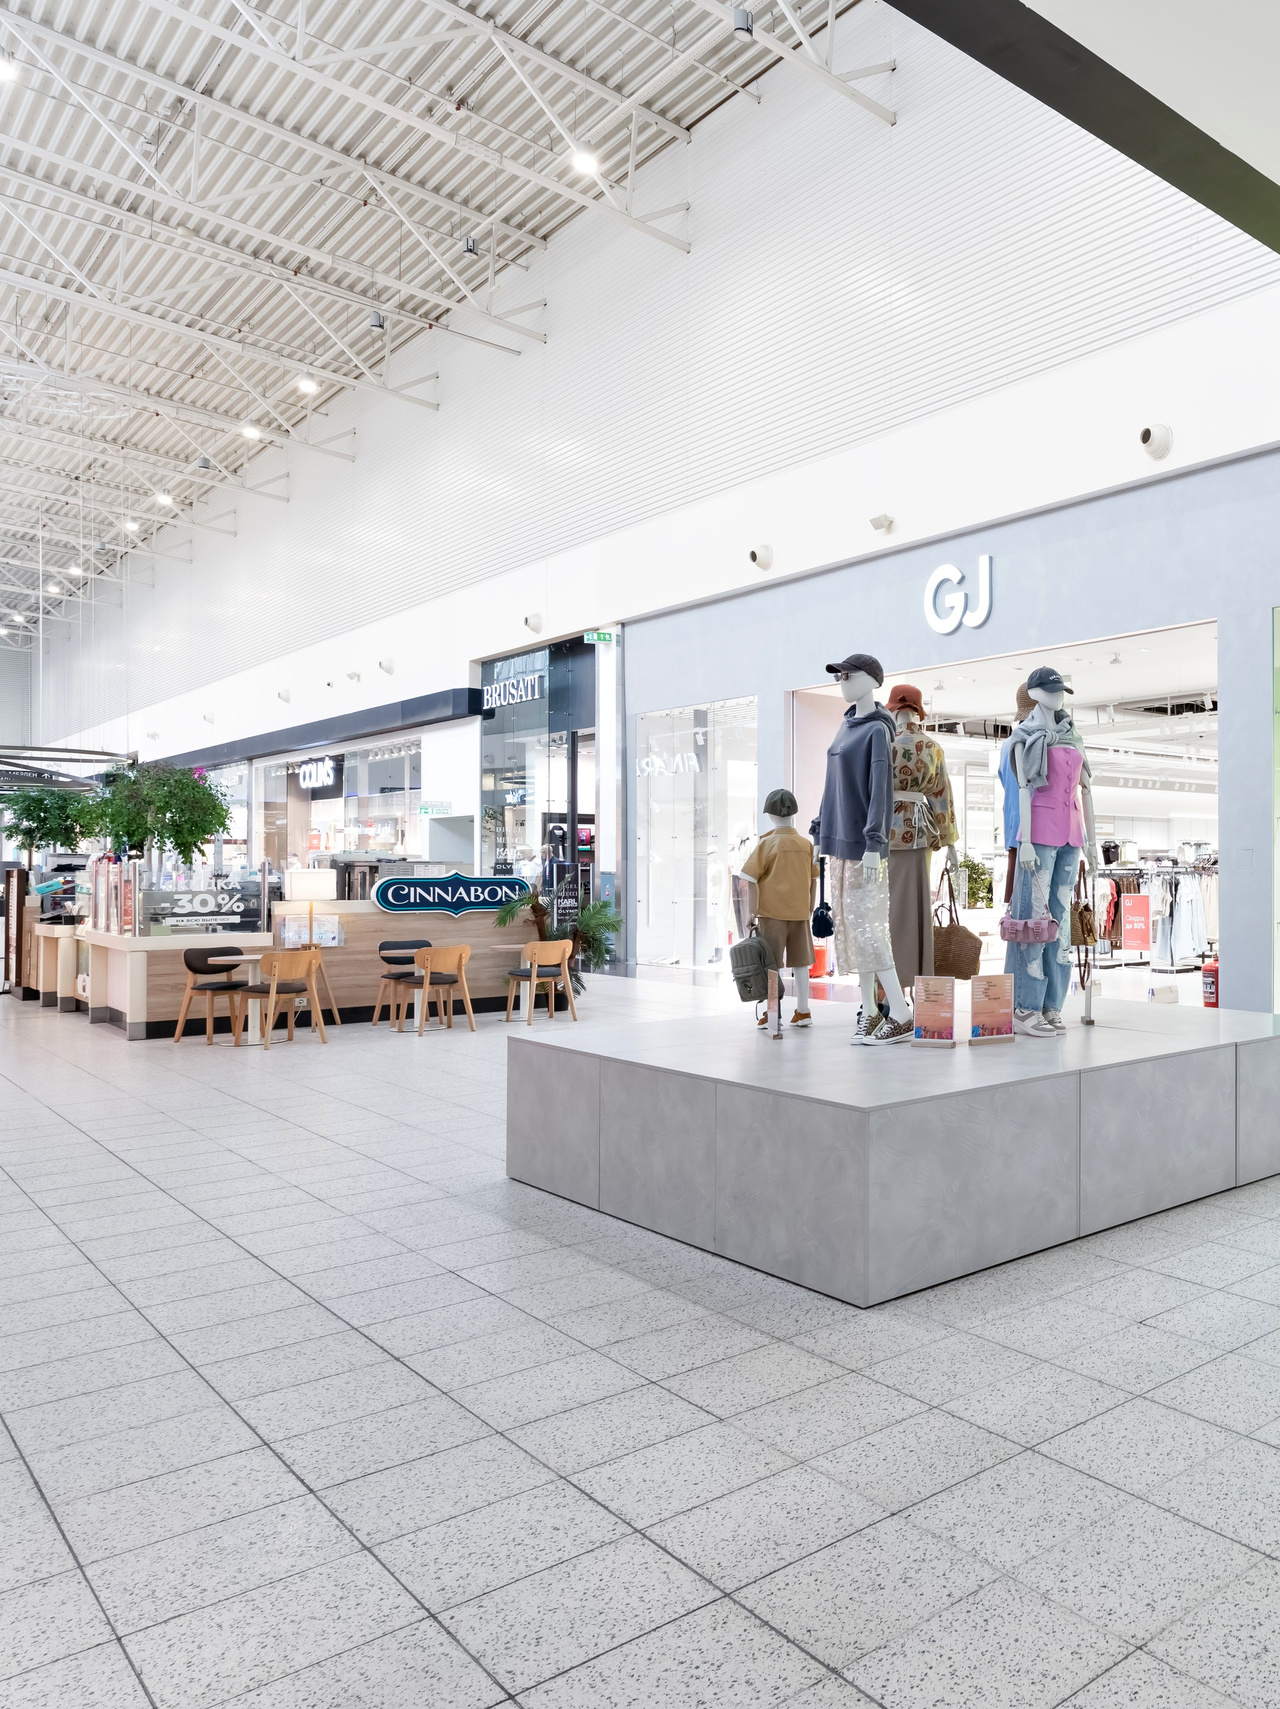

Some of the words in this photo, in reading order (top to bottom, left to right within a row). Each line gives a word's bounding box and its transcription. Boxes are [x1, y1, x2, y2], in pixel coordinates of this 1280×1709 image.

[924, 554, 993, 636] GJ
[482, 674, 540, 710] BRUSATI
[161, 893, 244, 913] -30%
[387, 884, 520, 904] CINNABON
